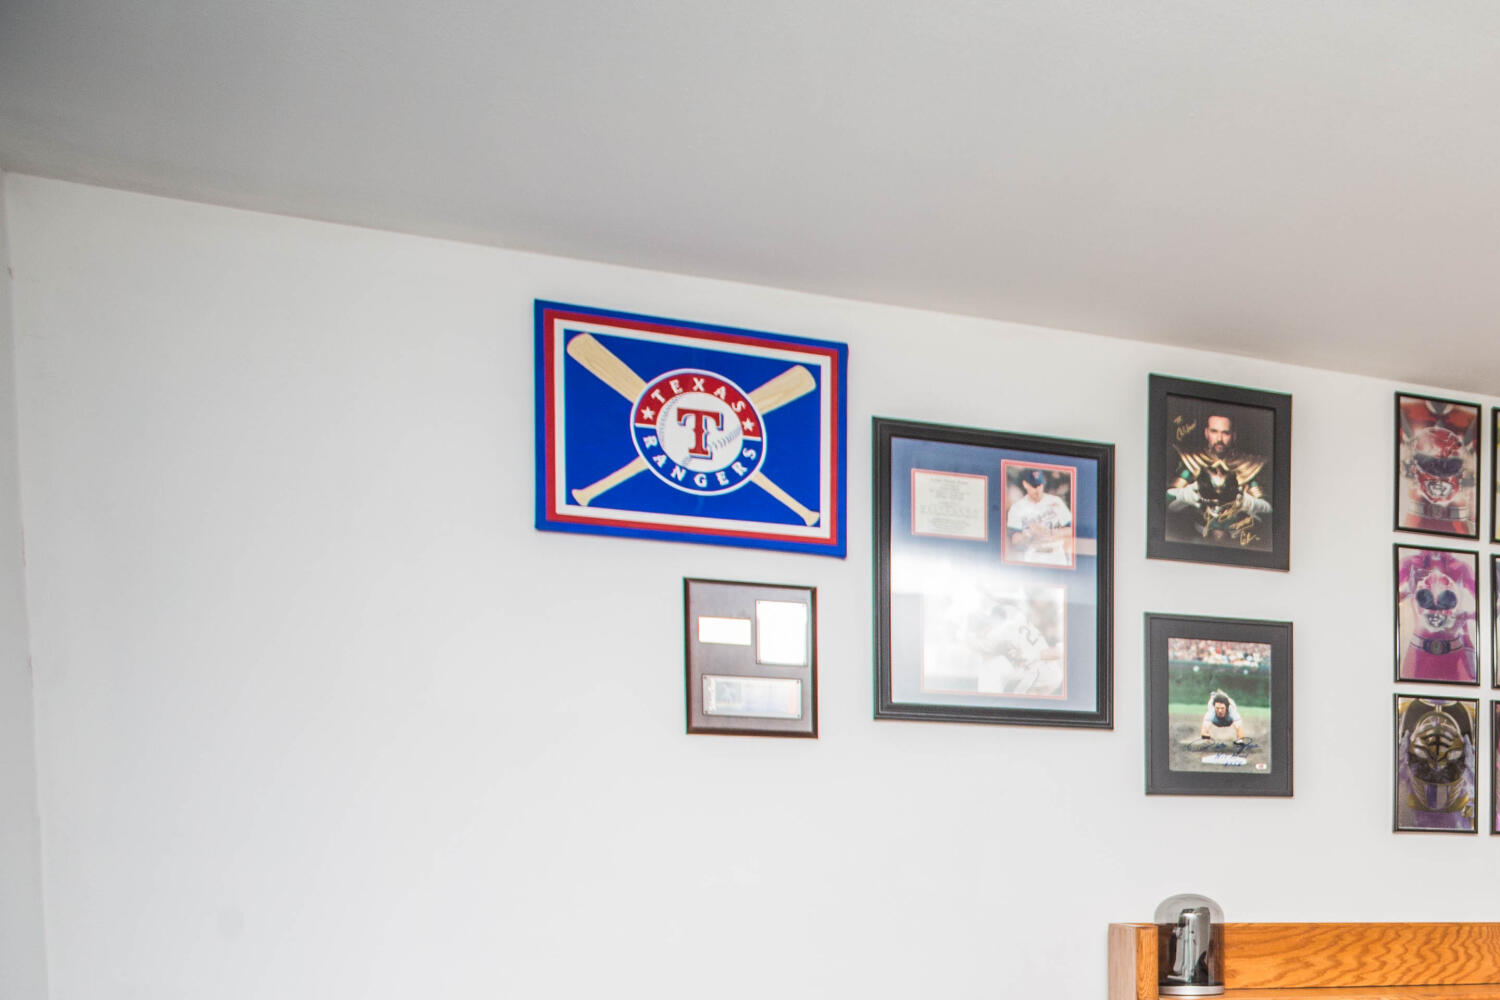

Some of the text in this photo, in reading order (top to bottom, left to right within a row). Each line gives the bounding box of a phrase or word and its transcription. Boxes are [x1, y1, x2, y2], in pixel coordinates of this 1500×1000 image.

[651, 377, 746, 413] TEXAS
[677, 407, 724, 460] T
[643, 435, 757, 487] RANGERS
